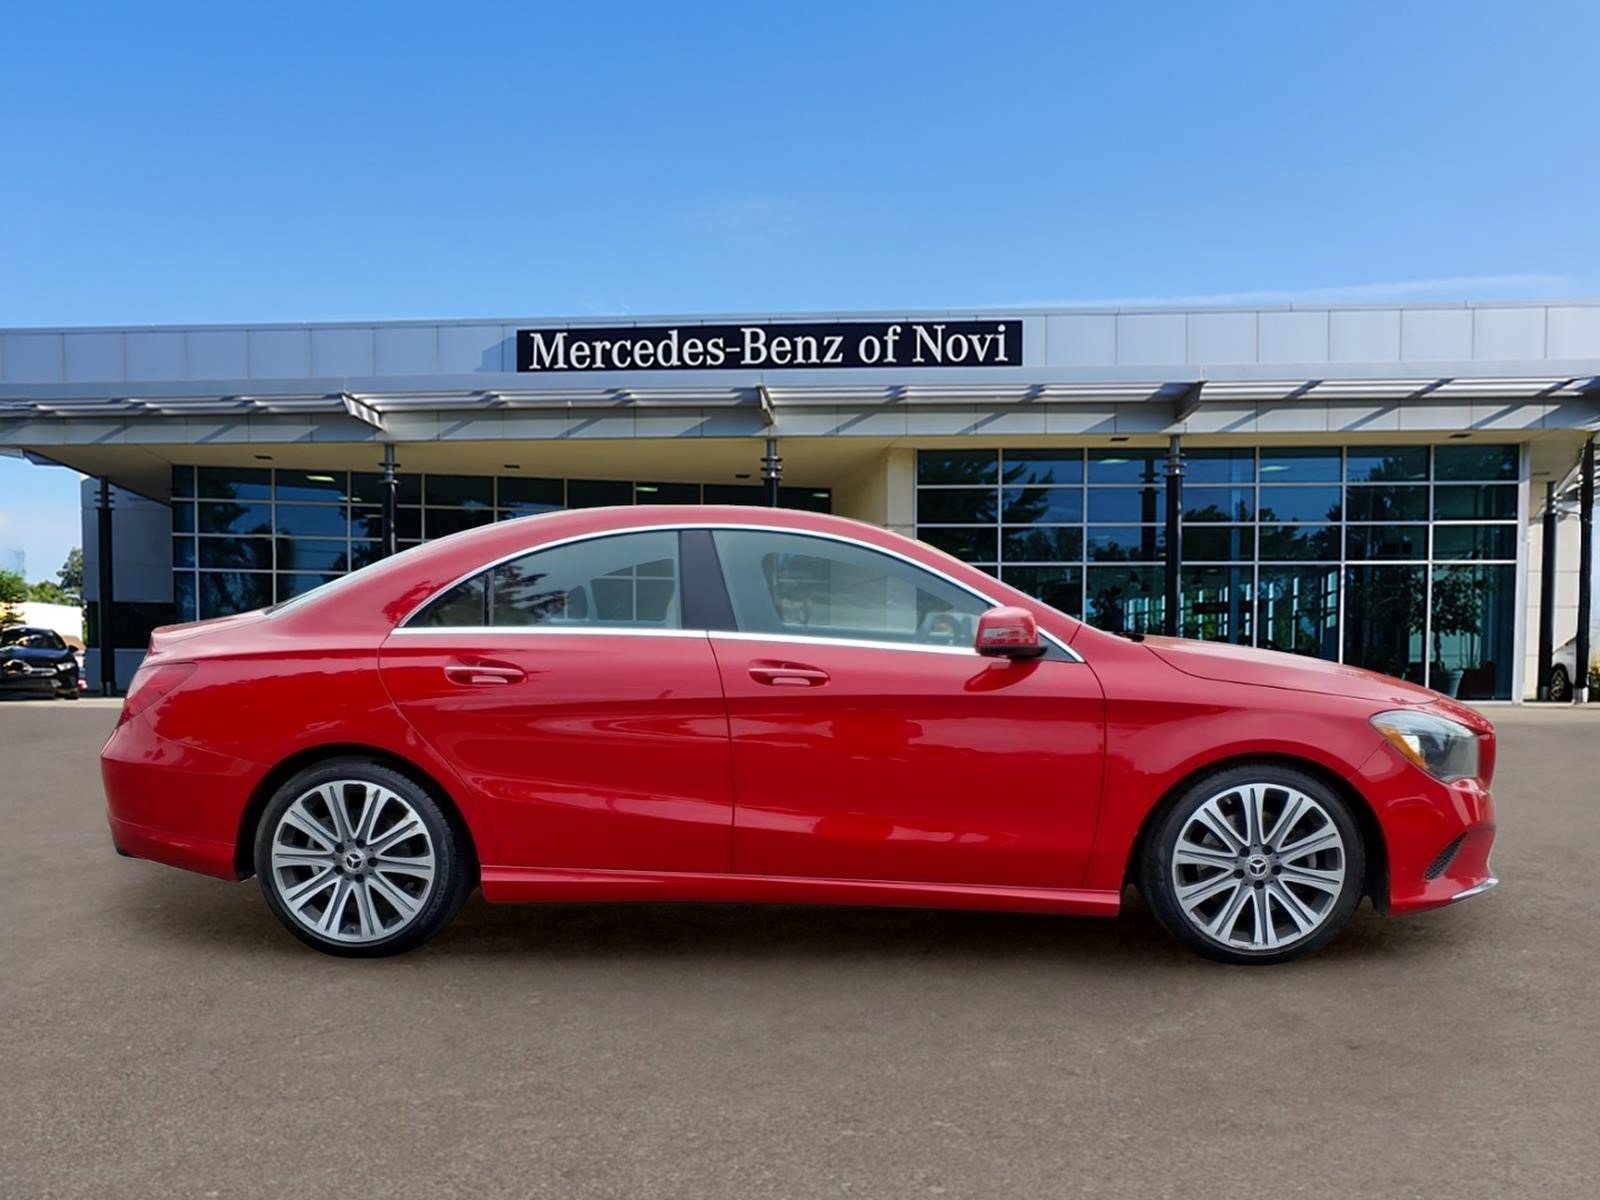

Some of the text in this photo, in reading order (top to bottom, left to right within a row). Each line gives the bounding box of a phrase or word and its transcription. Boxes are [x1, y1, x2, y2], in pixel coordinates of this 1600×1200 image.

[529, 324, 1008, 369] Mercedes-Benz of Novi
